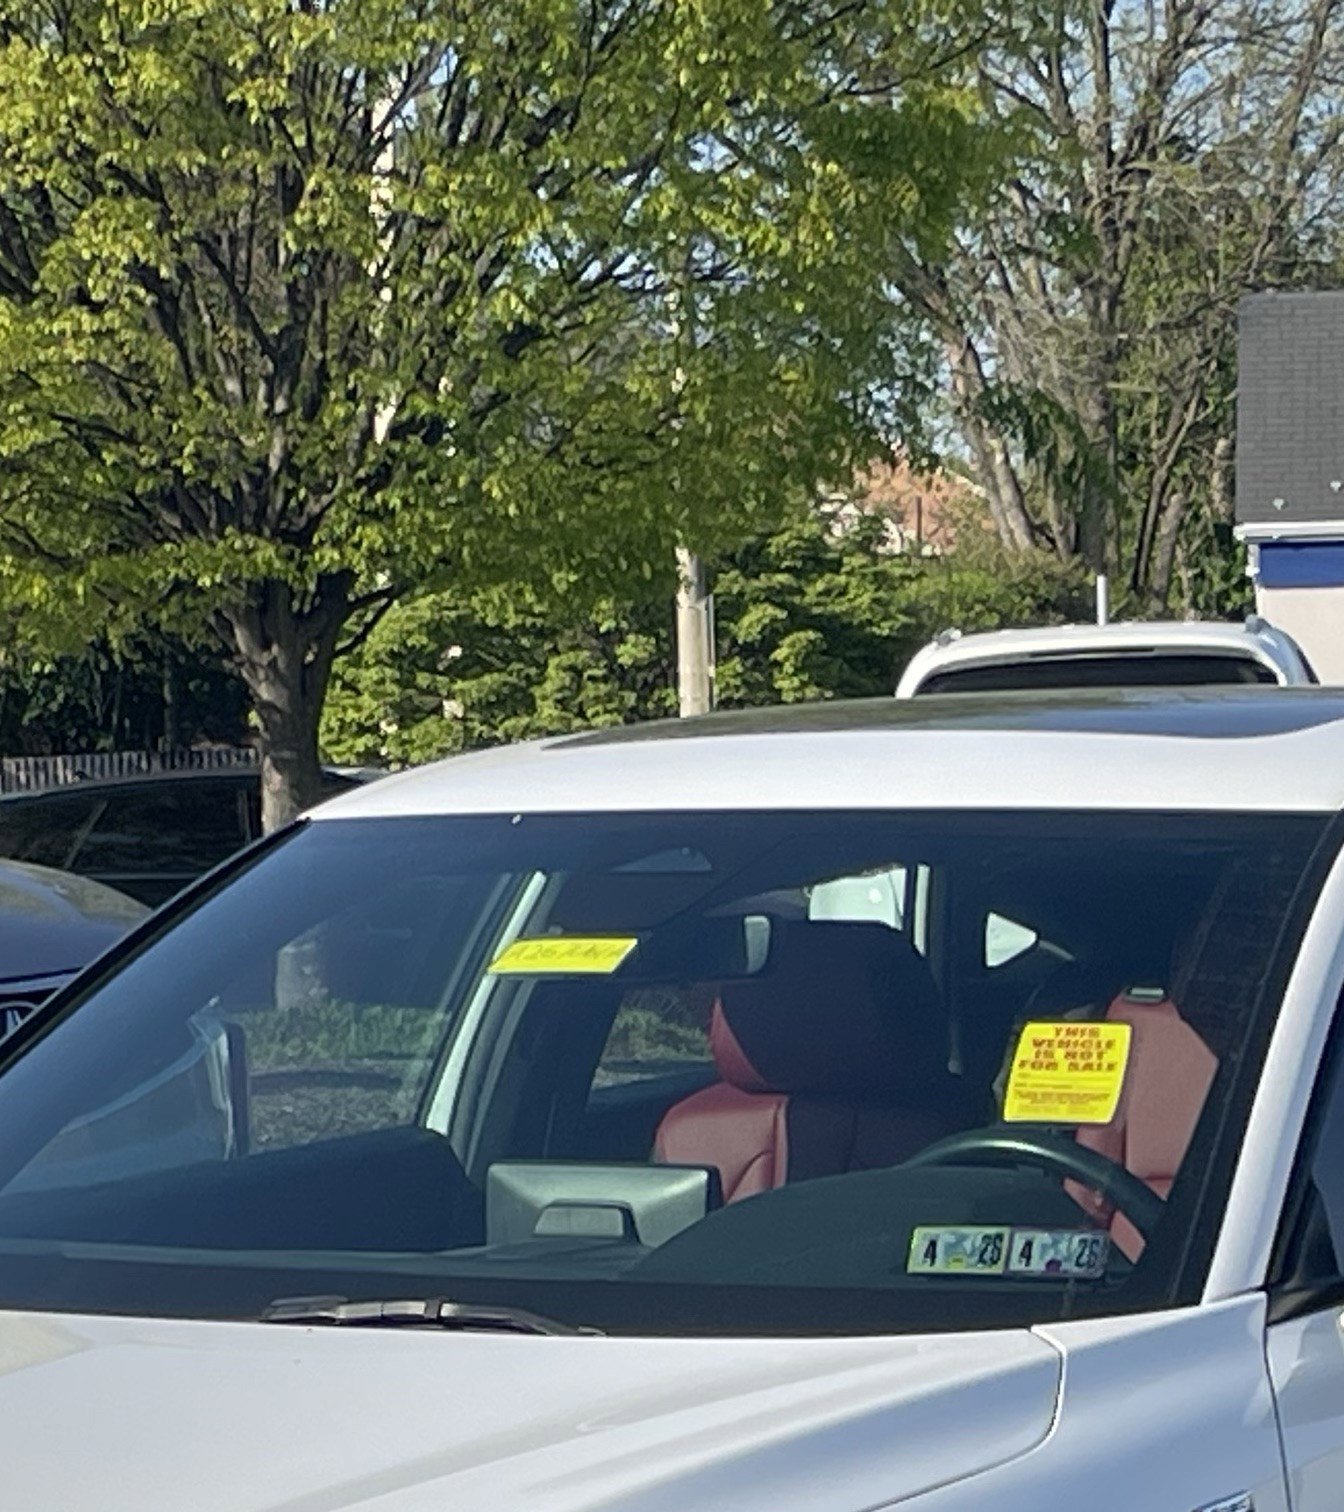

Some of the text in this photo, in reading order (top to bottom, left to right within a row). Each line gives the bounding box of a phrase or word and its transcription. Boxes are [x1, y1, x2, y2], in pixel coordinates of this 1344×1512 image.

[1054, 1026, 1101, 1037] THIS
[1032, 1039, 1116, 1049] VEHICLE
[923, 1239, 938, 1267] 4
[1019, 1239, 1034, 1267] 4
